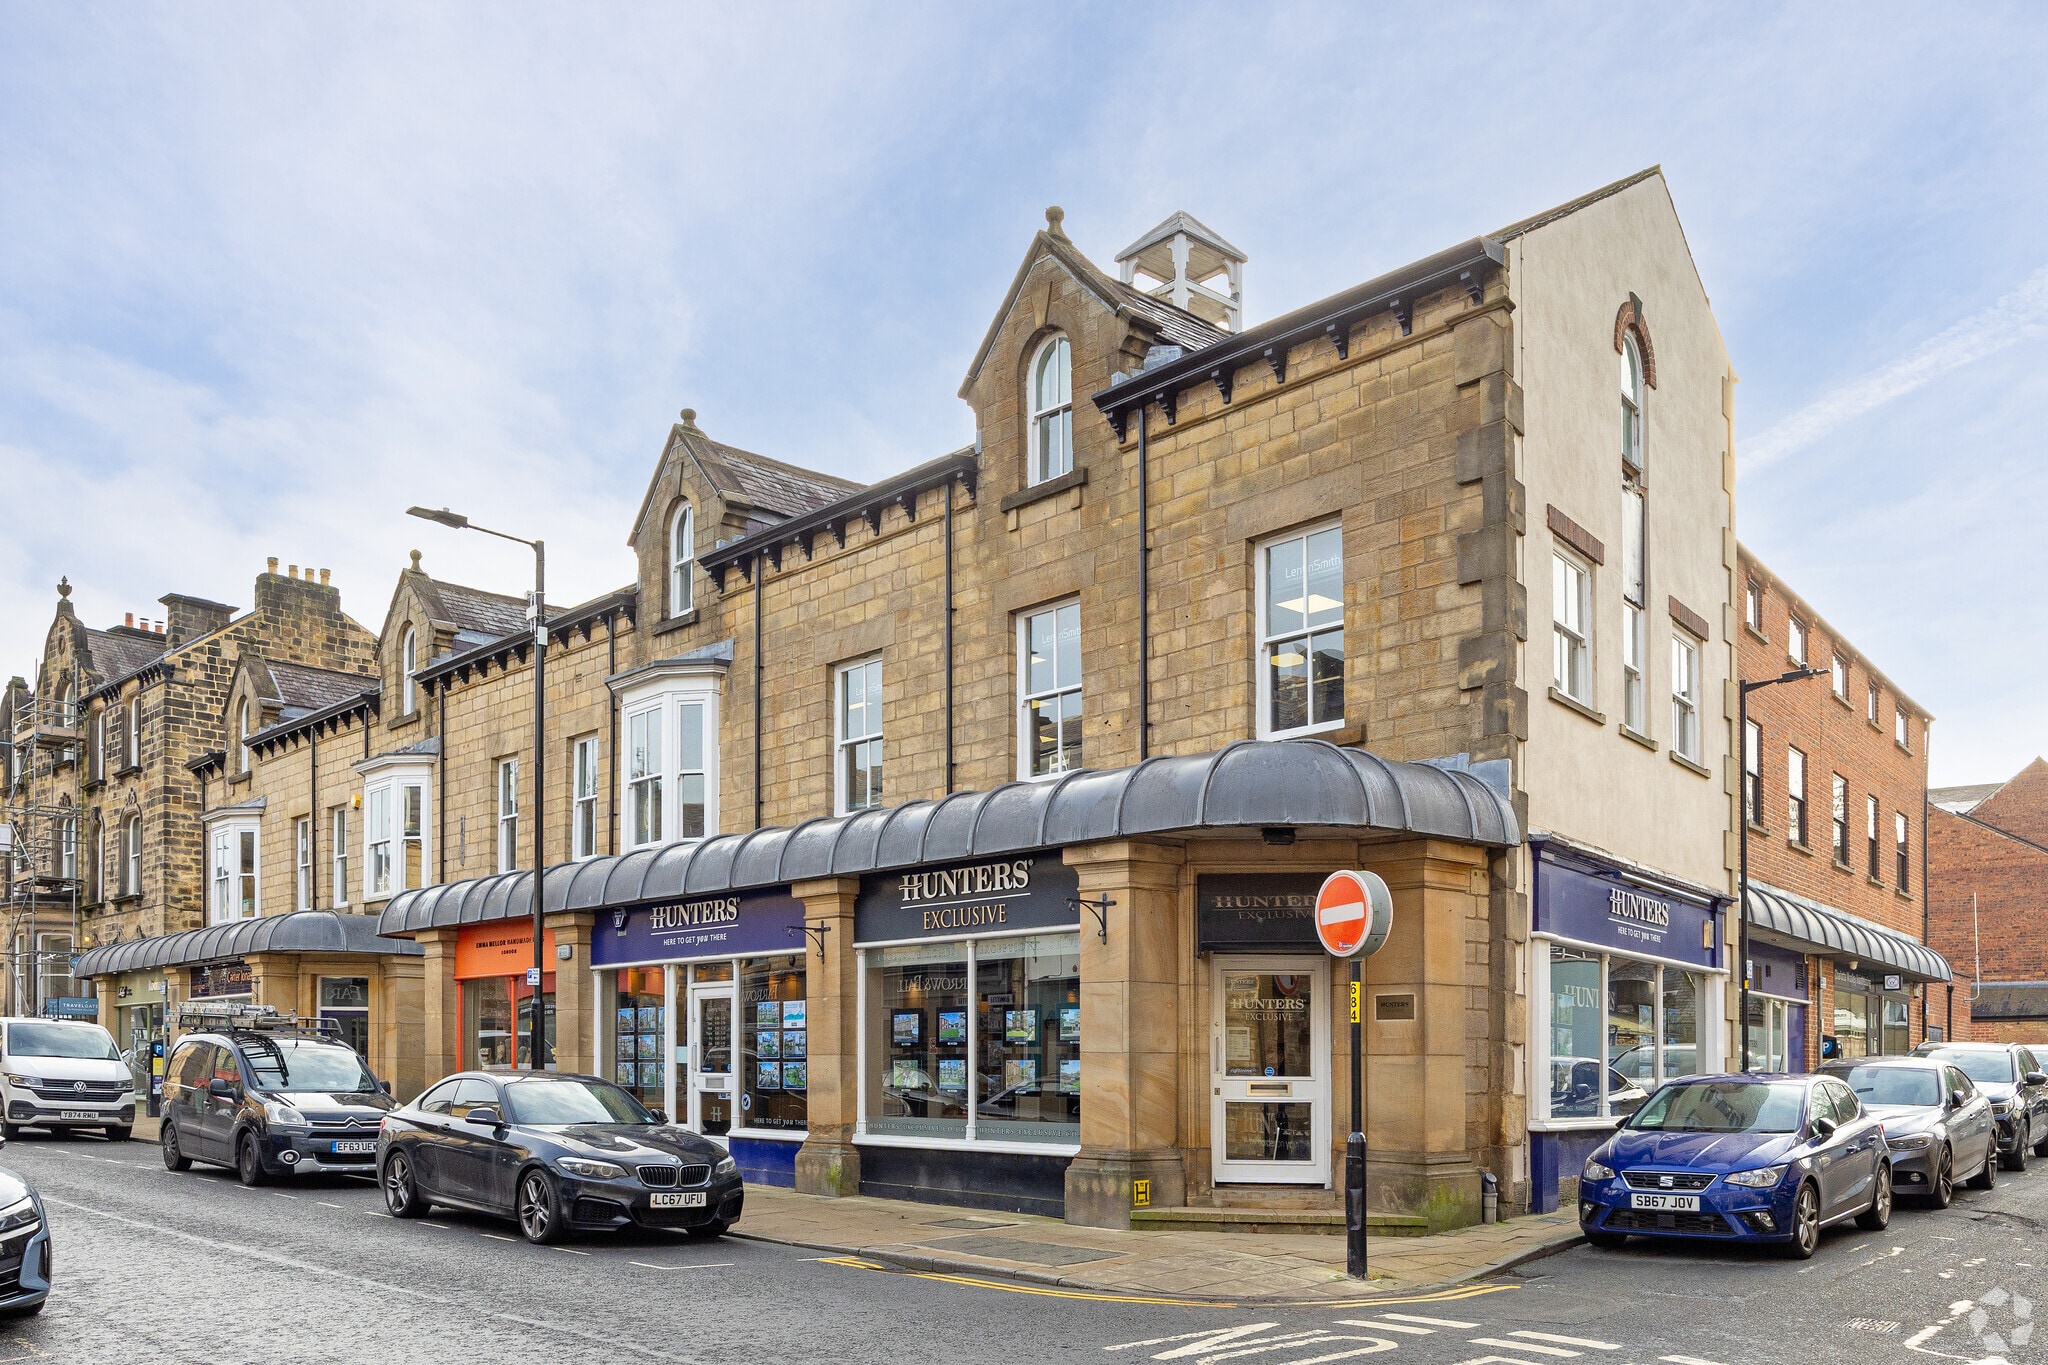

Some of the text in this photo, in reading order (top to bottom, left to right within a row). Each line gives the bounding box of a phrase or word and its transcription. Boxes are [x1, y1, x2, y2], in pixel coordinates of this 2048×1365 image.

[1285, 554, 1341, 579] LennSmith
[899, 859, 1030, 901] HUNTERS
[1211, 895, 1317, 908] HUNTER
[1610, 887, 1669, 927] HUNTERS
[650, 897, 738, 929] HUNTERS
[923, 903, 1007, 930] EXCLUSIVE
[1617, 926, 1627, 936] HERE
[1627, 928, 1633, 937] TO
[476, 941, 488, 949] EMMA
[663, 933, 727, 946] HERE TO GET you THERE
[1230, 998, 1304, 1010] HUNTERS
[1245, 1013, 1293, 1021] EXCLUSIVE
[337, 1142, 360, 1151] EF63
[655, 1193, 703, 1205] LC67 UFU
[1636, 1195, 1694, 1209] SB67 JOV
